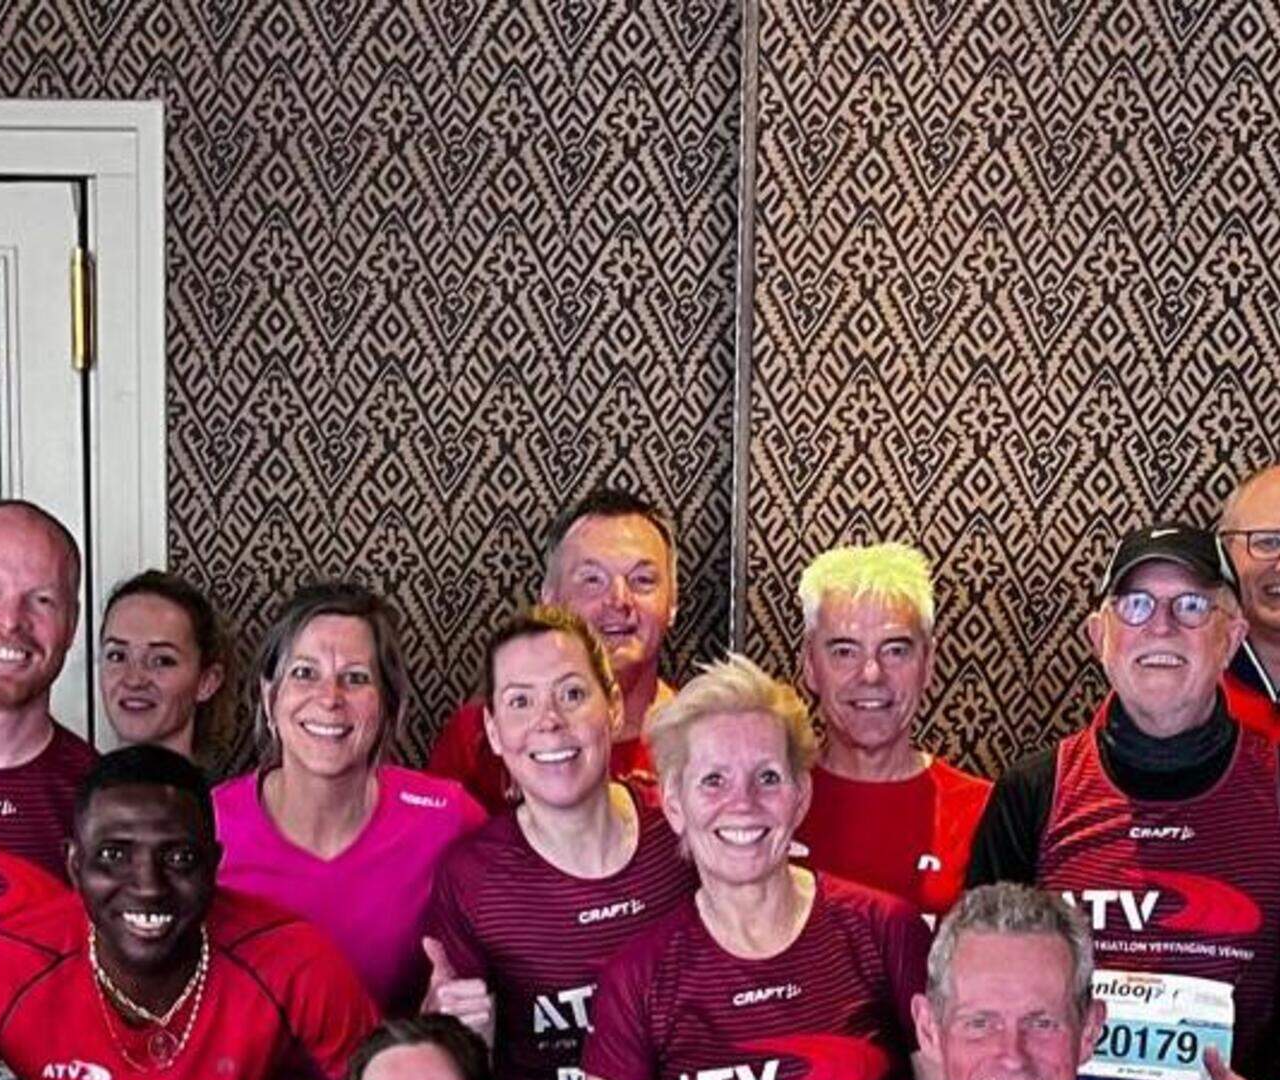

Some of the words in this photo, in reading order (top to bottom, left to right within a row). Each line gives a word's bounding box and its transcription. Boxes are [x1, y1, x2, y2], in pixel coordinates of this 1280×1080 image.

[1129, 827, 1181, 839] CRAFT
[579, 902, 629, 925] CRAFT
[732, 984, 786, 1007] CRAFT
[533, 985, 598, 1033] AT
[1093, 1024, 1198, 1064] 20179
[42, 1064, 82, 1080] ATV
